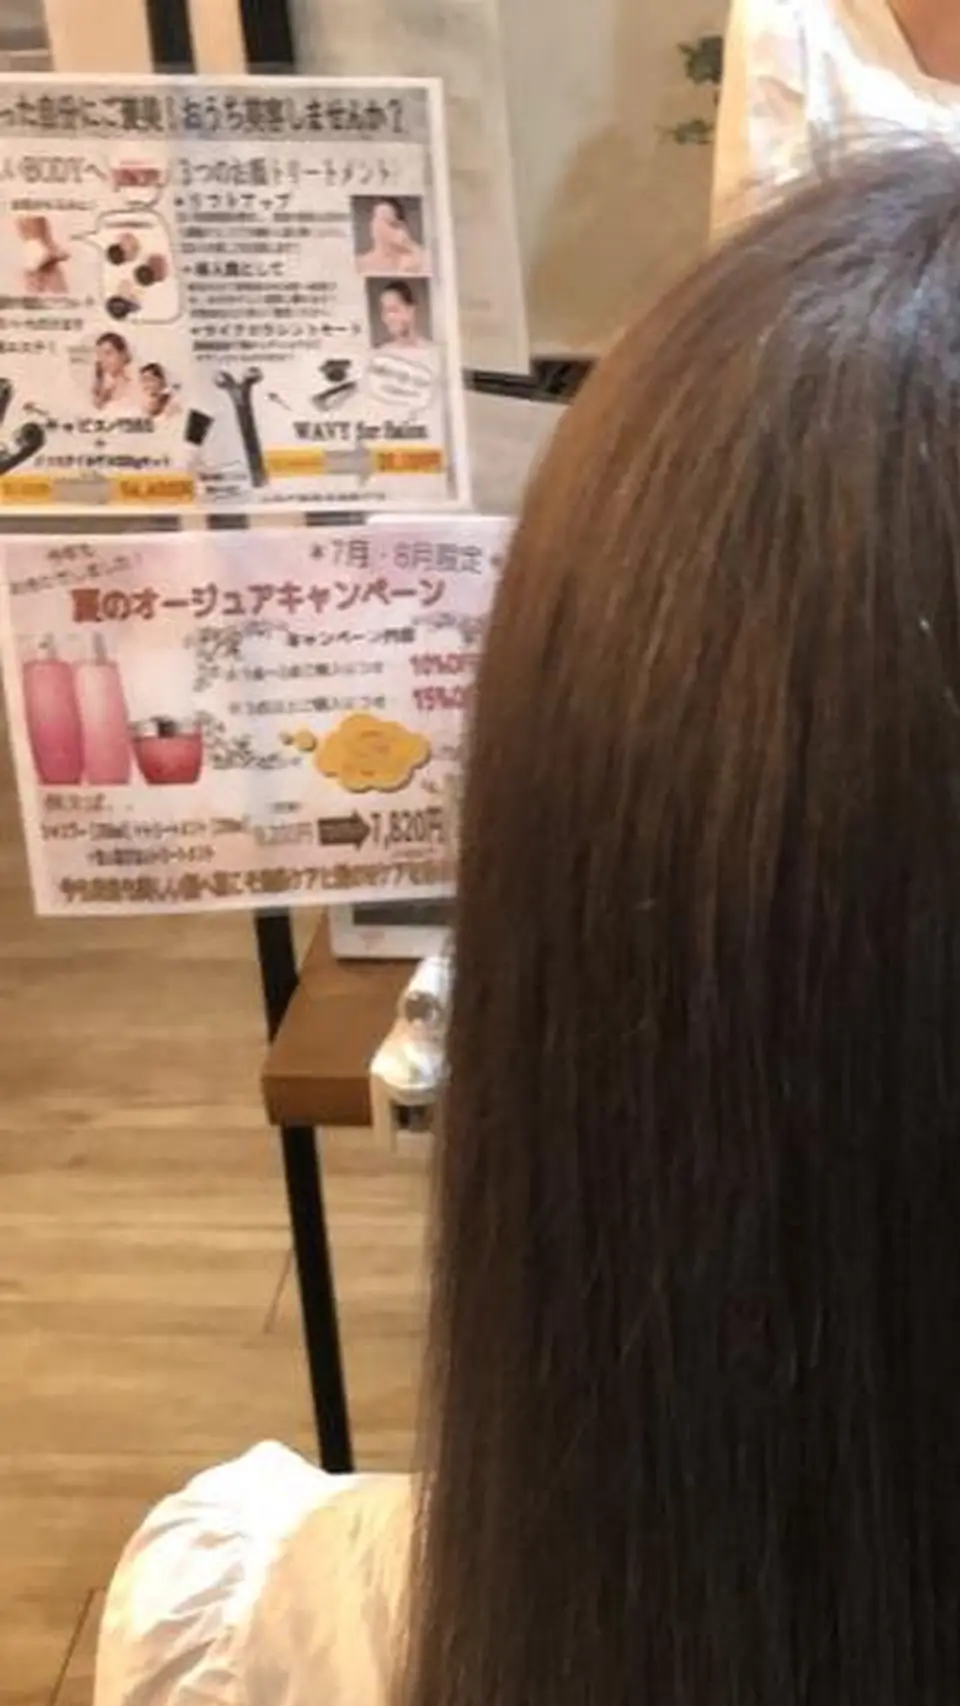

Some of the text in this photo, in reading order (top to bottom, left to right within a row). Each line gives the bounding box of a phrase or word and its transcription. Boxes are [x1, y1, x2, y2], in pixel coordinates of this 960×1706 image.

[70, 578, 447, 623] 夏のオージュアキャンペーン
